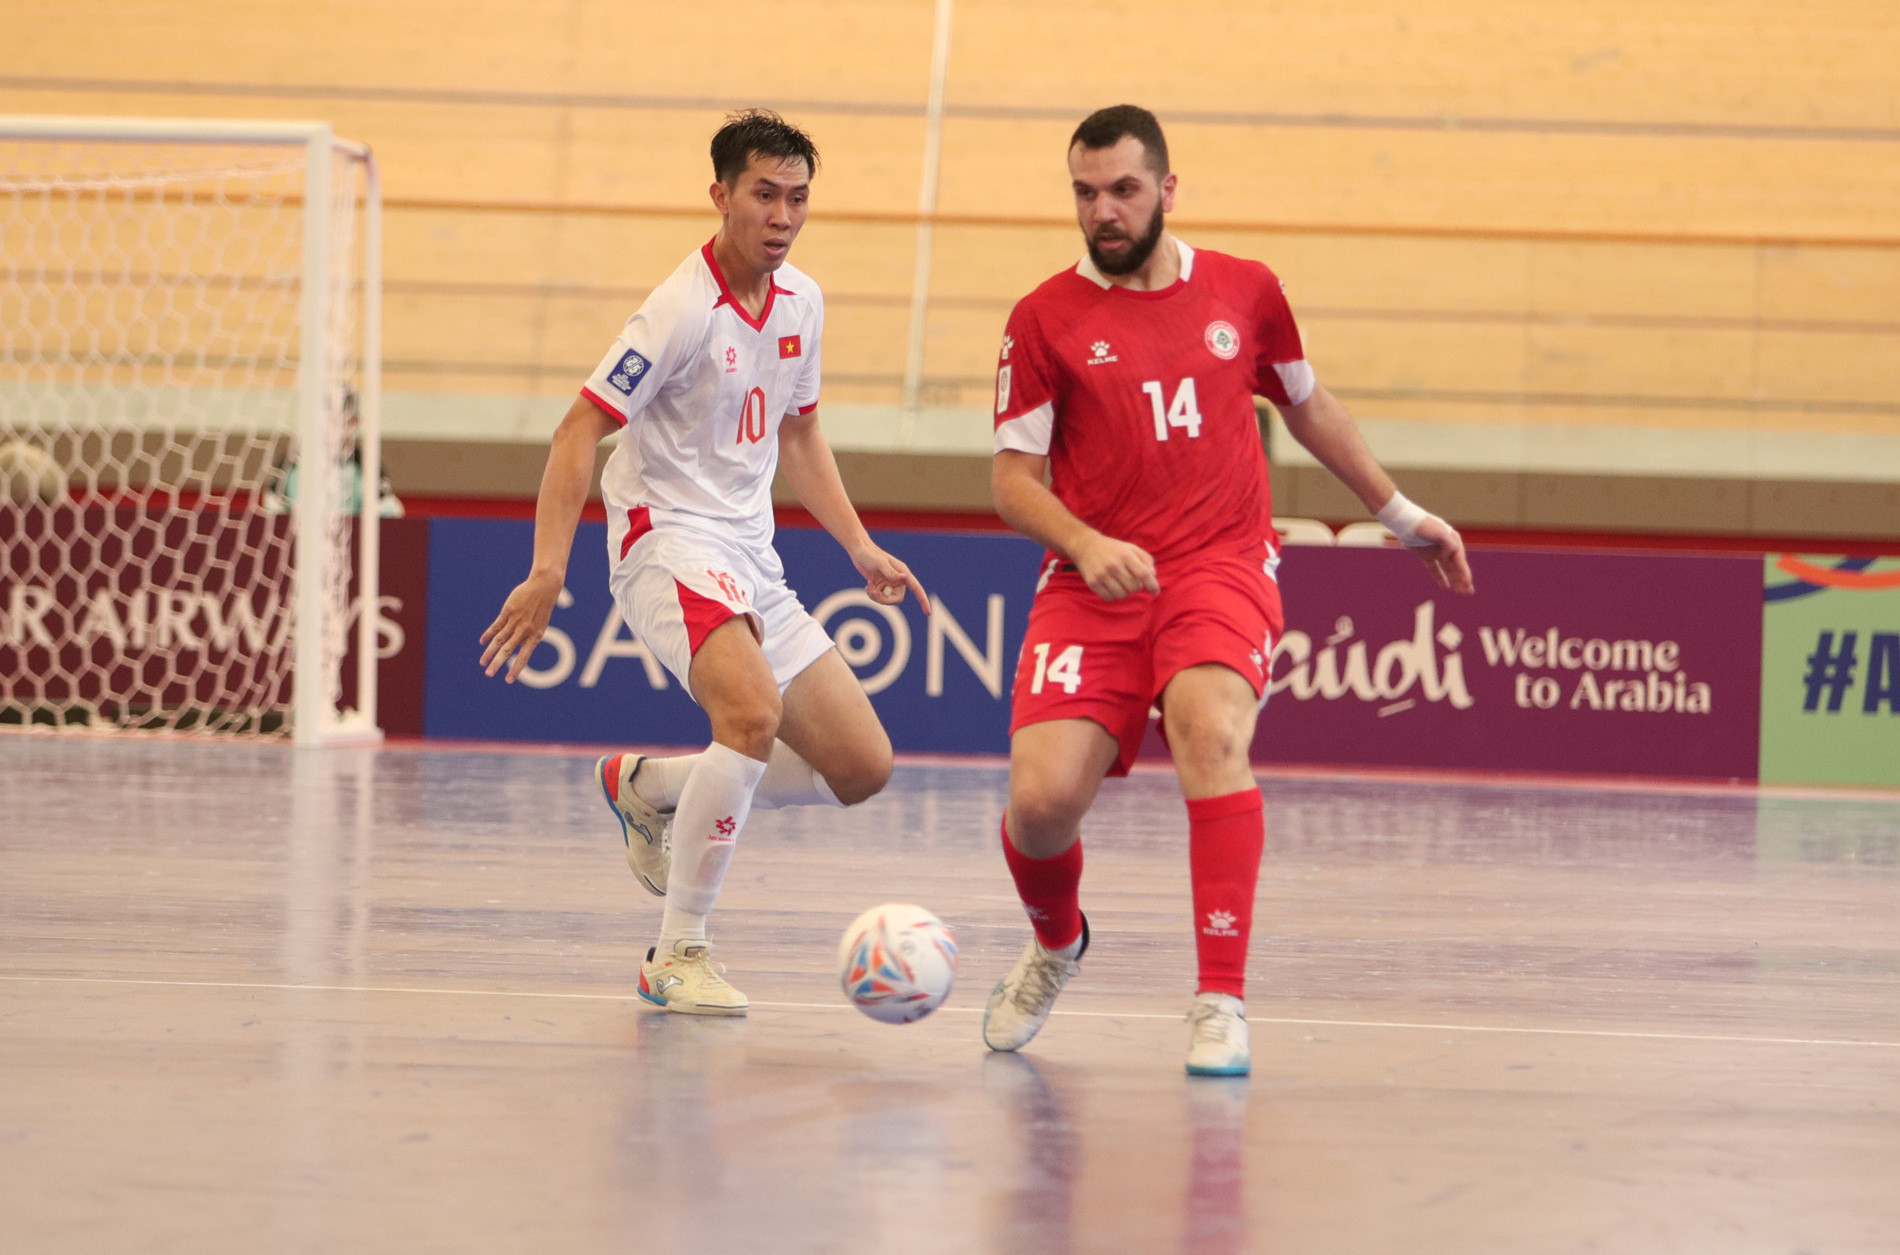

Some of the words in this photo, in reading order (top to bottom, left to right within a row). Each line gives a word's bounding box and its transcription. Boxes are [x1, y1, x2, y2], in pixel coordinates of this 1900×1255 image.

[1087, 355, 1118, 365] KELME
[736, 386, 765, 444] 10
[1142, 377, 1203, 441] 14
[1031, 643, 1084, 694] 14
[1478, 626, 1680, 673] Welcome
[1515, 672, 1561, 709] to
[1570, 670, 1712, 714] Arabia
